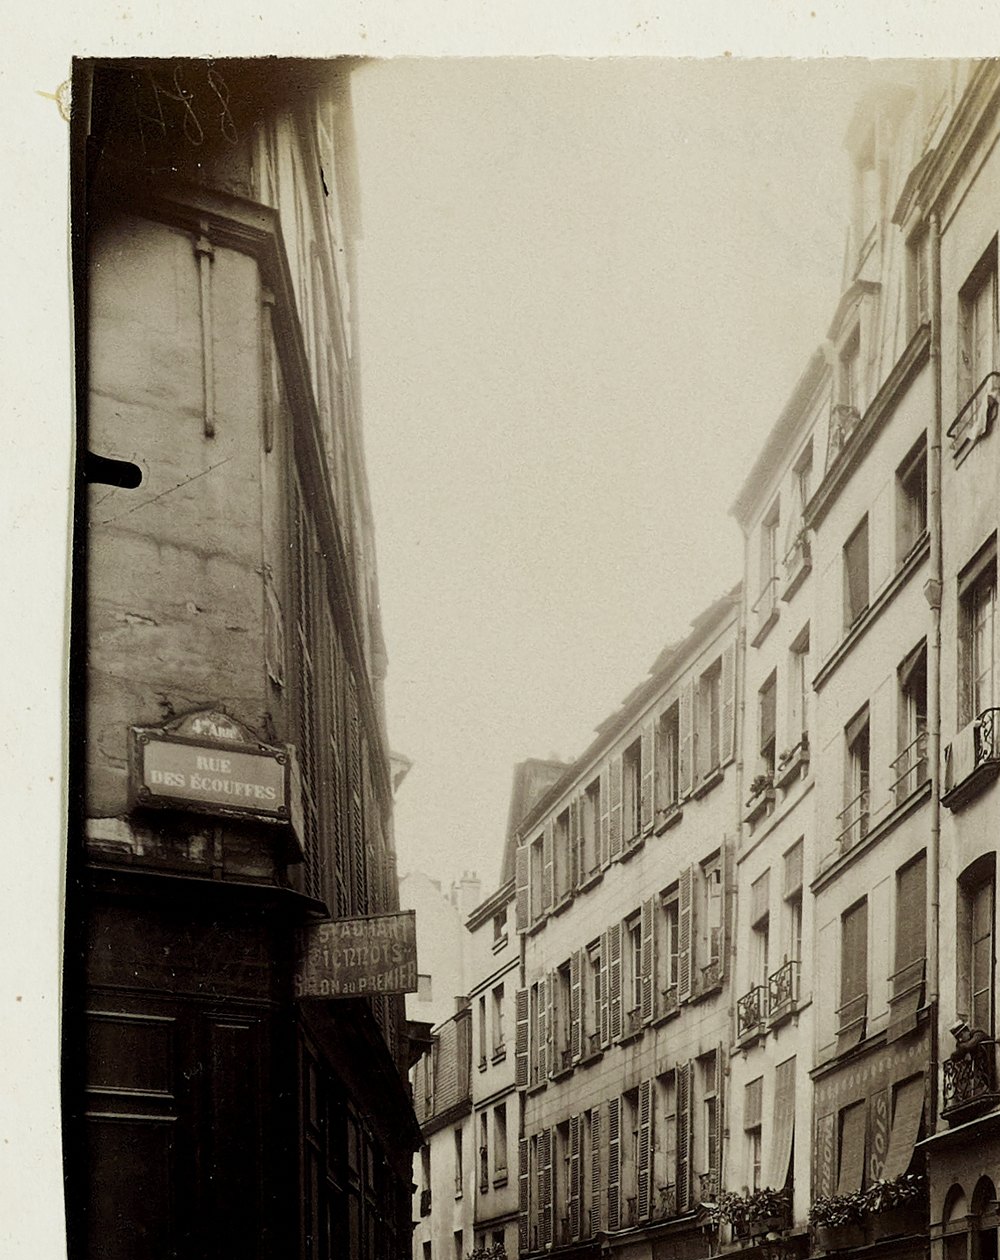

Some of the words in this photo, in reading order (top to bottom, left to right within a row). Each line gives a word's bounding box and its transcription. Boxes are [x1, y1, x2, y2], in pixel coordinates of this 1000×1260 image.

[197, 755, 232, 774] RUE
[151, 769, 186, 788] DES
[189, 772, 277, 801] ÉCOUFFES
